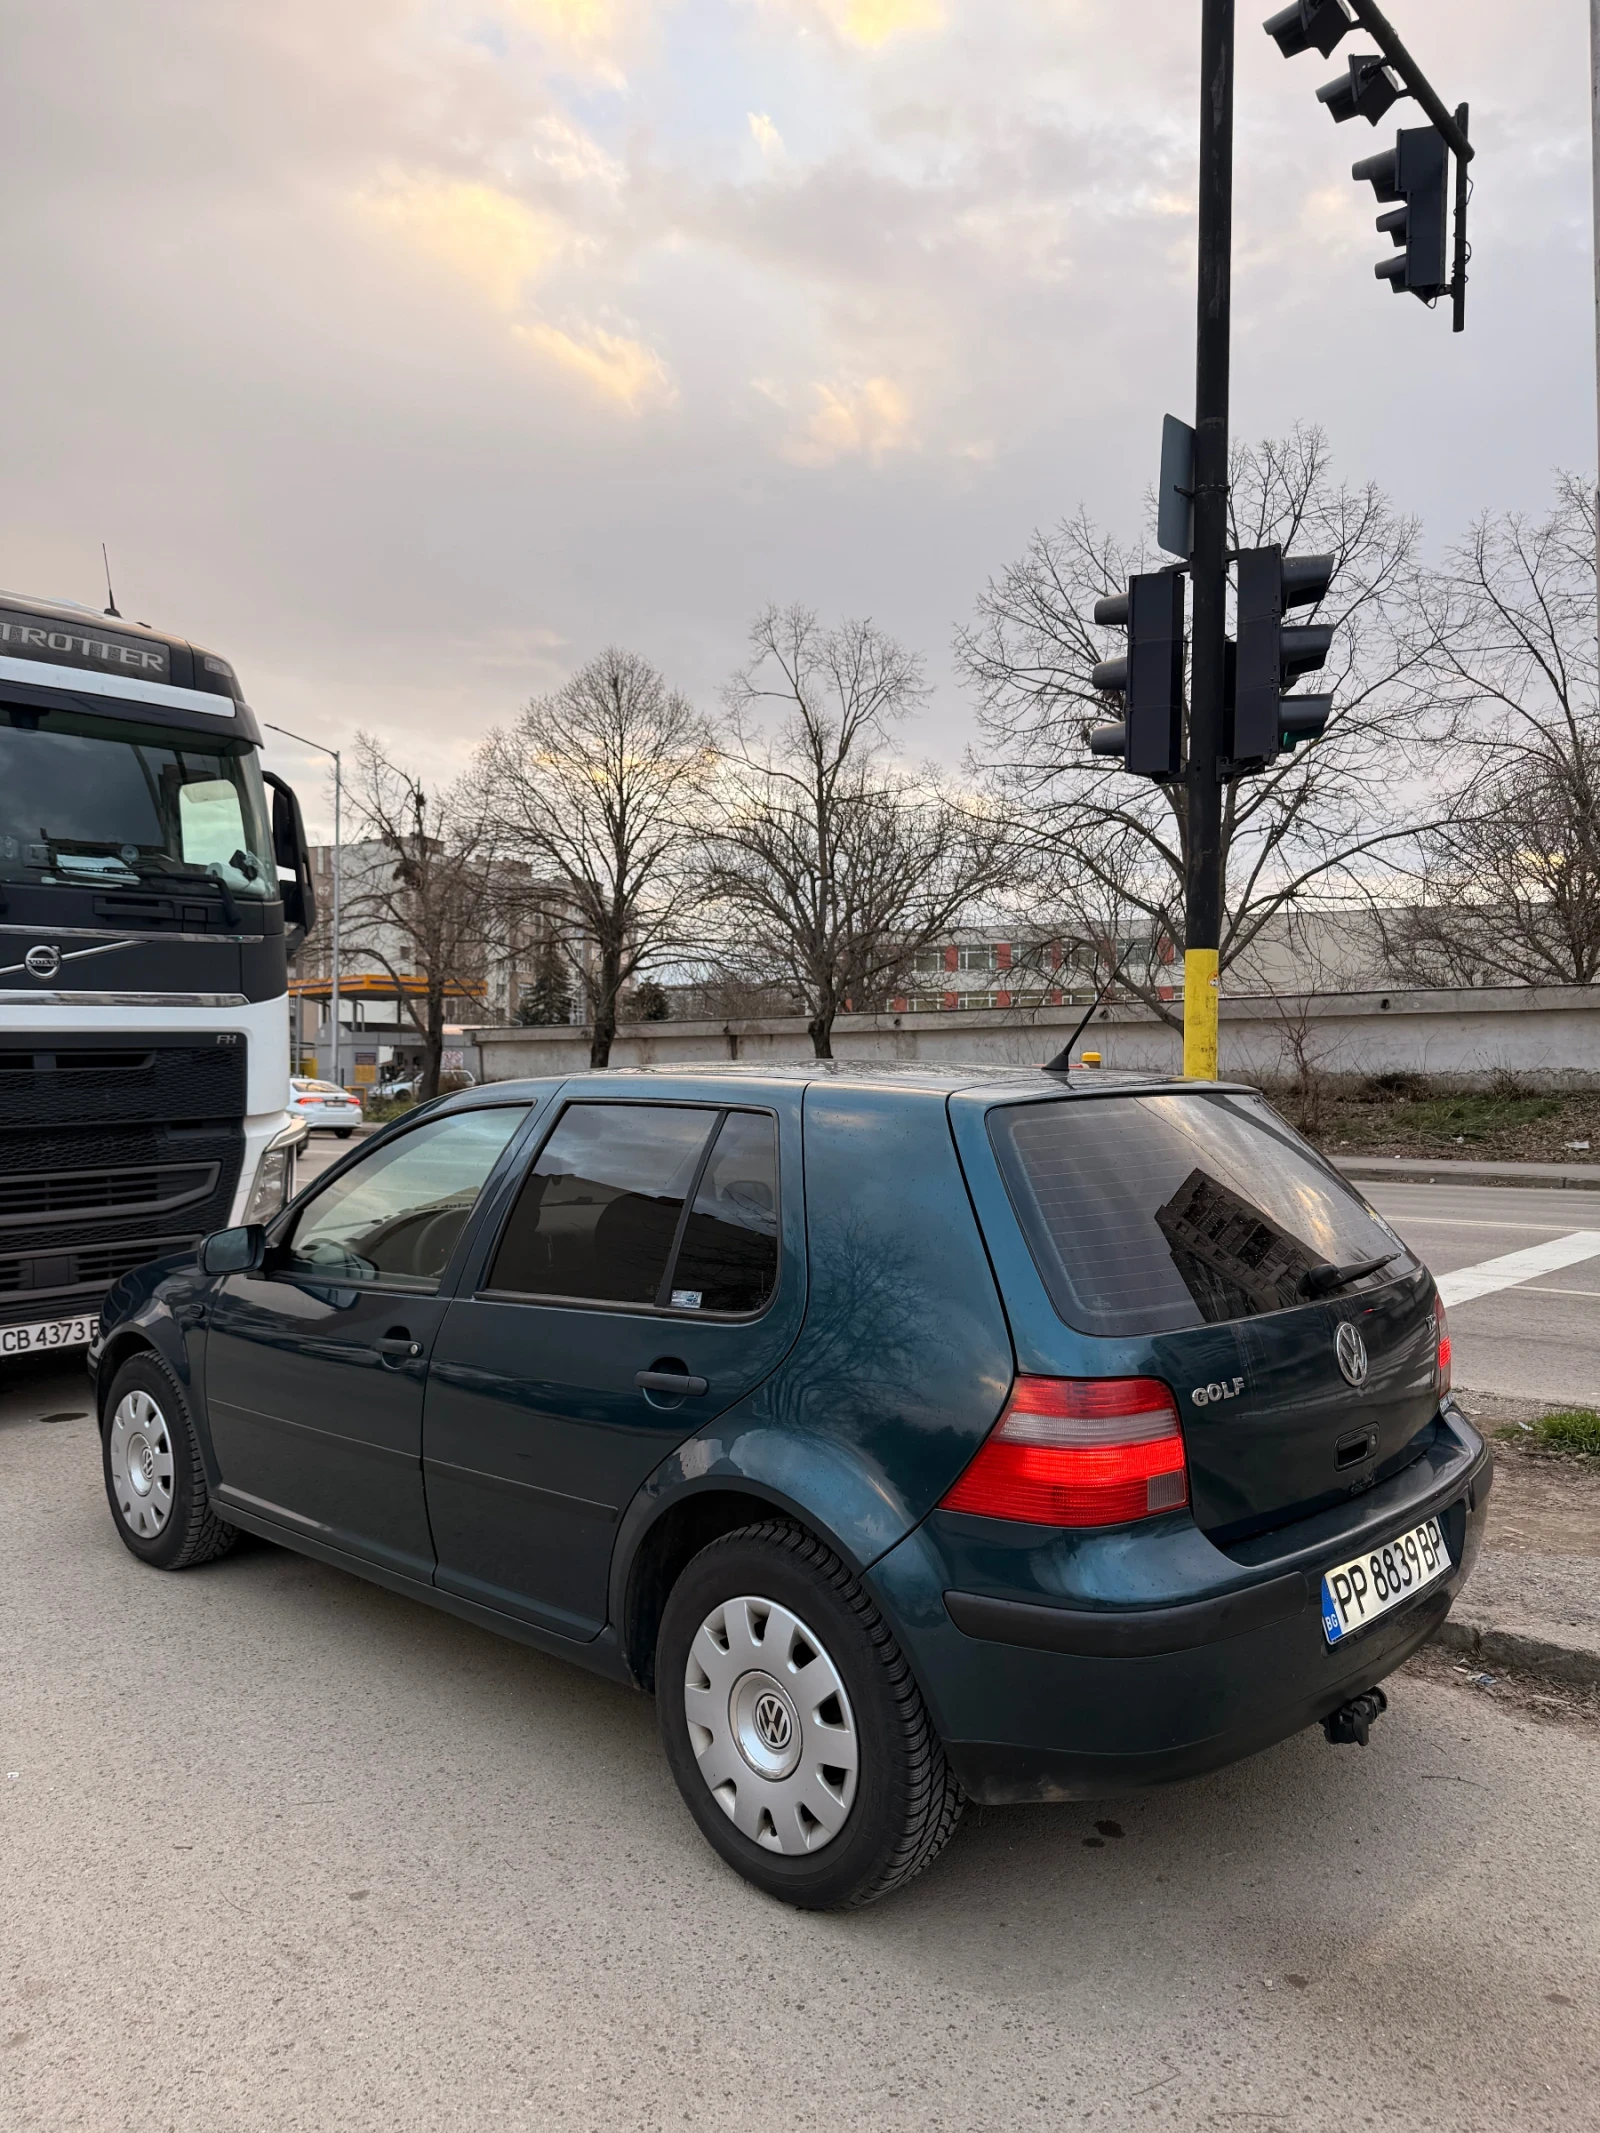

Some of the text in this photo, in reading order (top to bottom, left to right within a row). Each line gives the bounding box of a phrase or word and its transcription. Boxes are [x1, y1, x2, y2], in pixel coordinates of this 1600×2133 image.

[217, 1035, 237, 1044] FH
[2, 1329, 31, 1351] CB
[36, 1321, 85, 1346] 4373
[1191, 1376, 1245, 1407] GOLF
[1331, 1520, 1441, 1624] PP 8839 BP
[1325, 1614, 1339, 1632] BG
